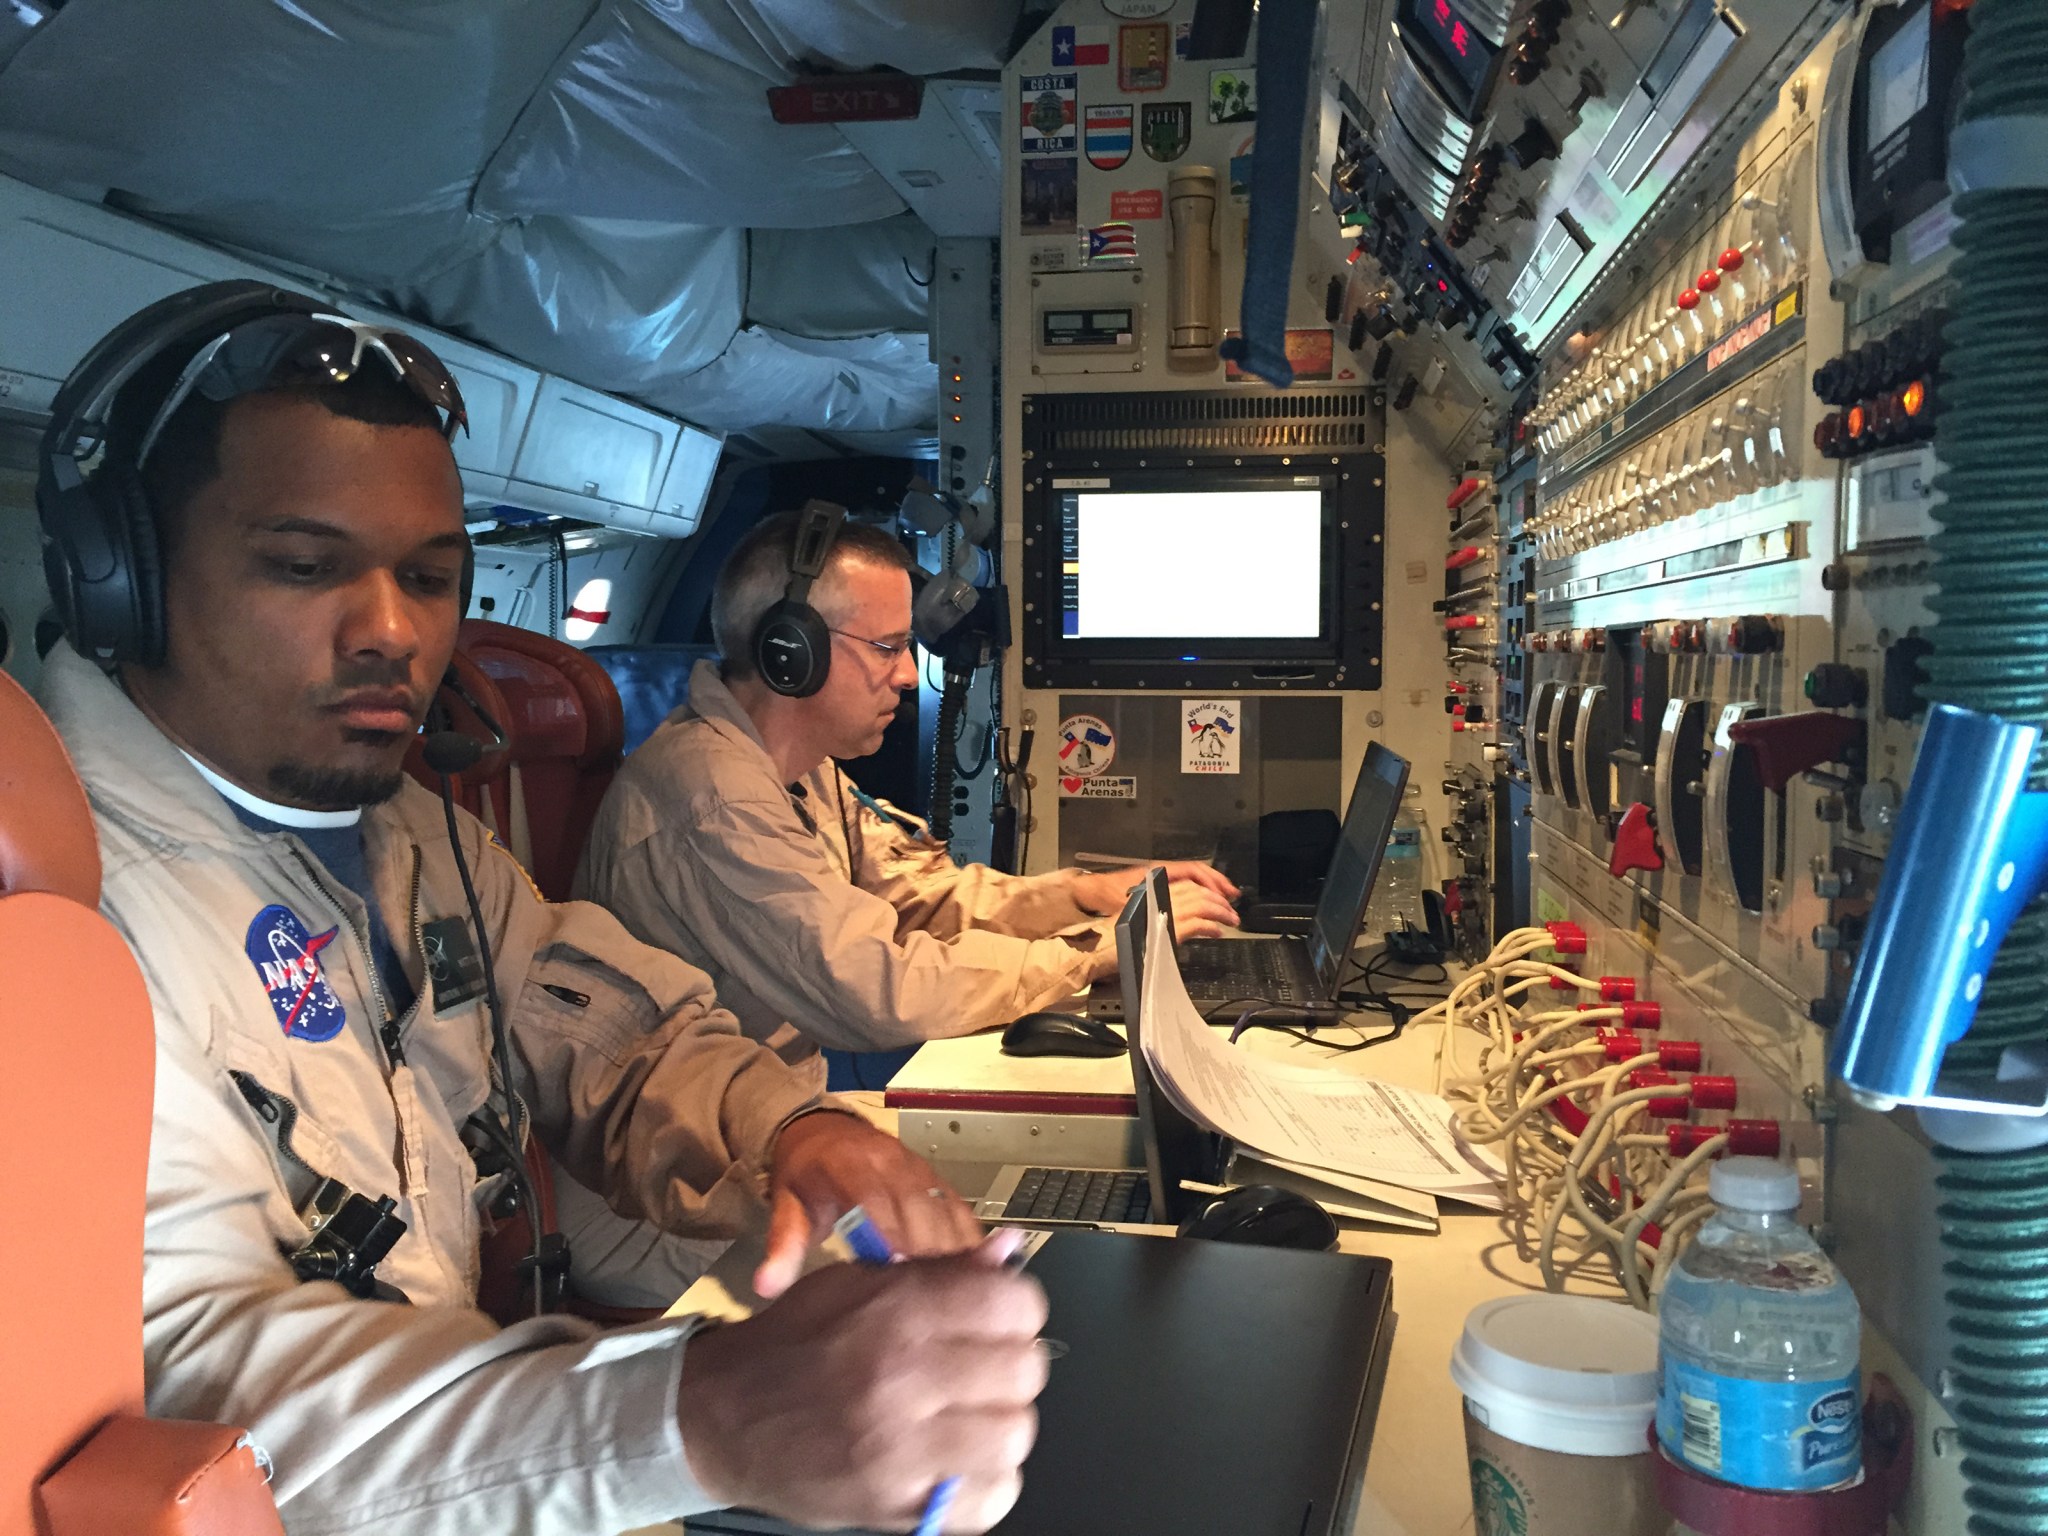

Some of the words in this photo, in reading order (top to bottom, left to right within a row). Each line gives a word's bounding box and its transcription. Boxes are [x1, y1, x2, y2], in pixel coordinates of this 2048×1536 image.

[1121, 4, 1157, 14] JAPAN
[1030, 77, 1066, 90] COSTA
[811, 91, 879, 113] EXIT
[1094, 109, 1125, 117] THAILAND
[1036, 138, 1064, 150] RICA
[1115, 196, 1158, 204] EMERGENCY
[1187, 703, 1217, 718] World's
[1219, 705, 1235, 719] End
[1058, 721, 1077, 736] Punta
[1078, 718, 1102, 730] Arenas
[1083, 778, 1119, 787] Punta
[1081, 787, 1125, 797] Arenas
